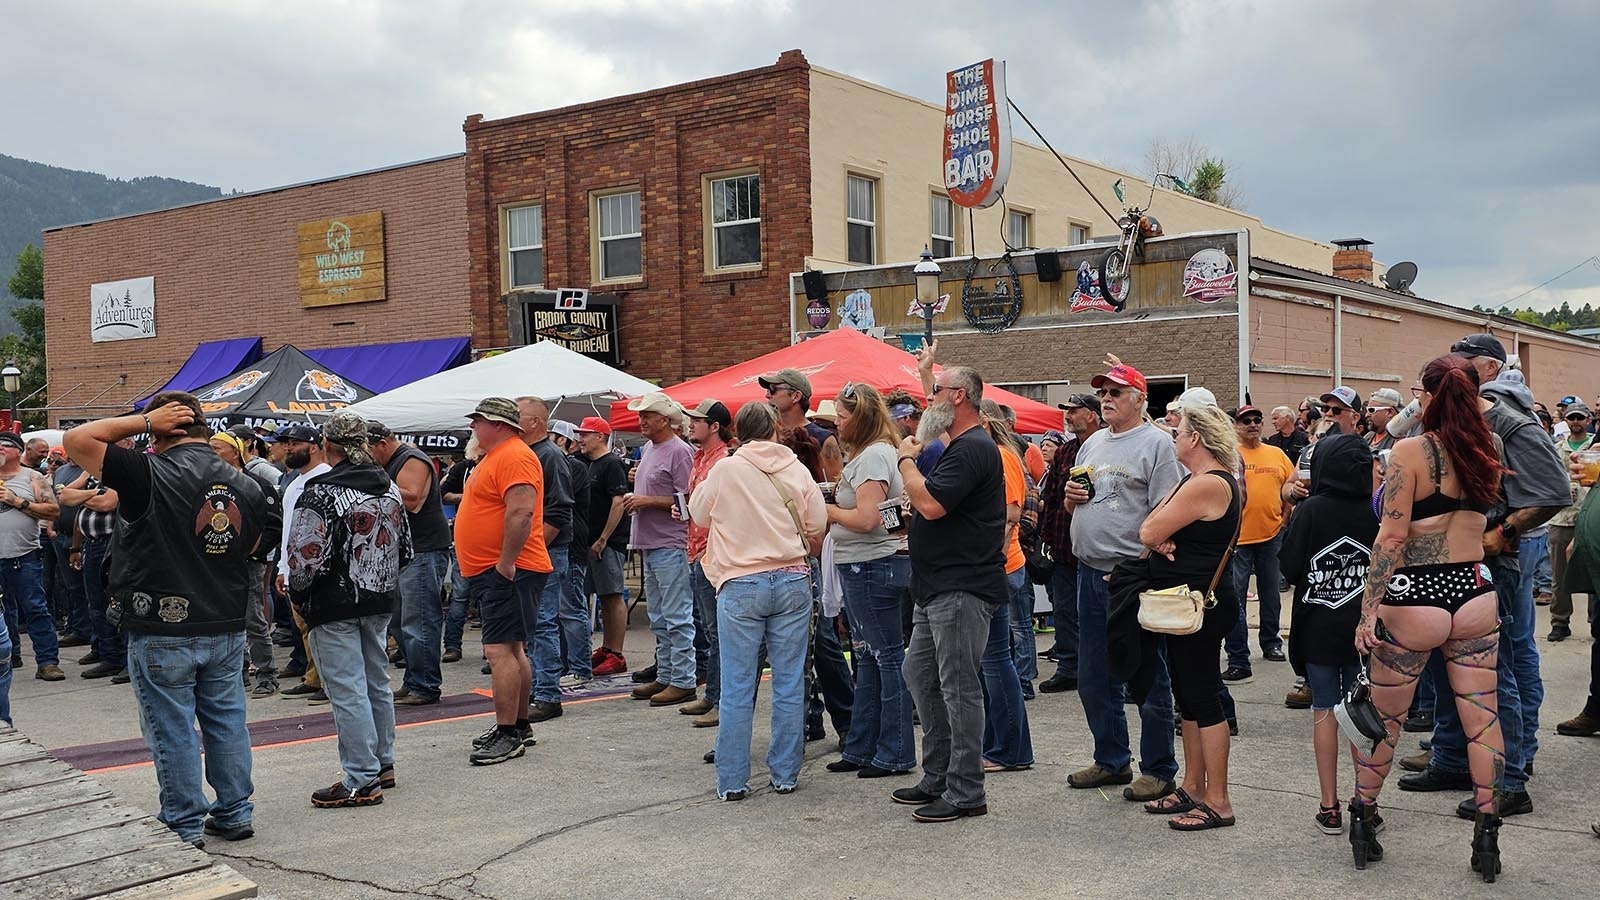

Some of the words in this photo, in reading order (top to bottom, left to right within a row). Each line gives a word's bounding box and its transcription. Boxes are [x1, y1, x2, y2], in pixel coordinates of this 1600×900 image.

[953, 64, 984, 87] THE
[948, 84, 989, 110] DIME
[945, 103, 993, 129] HORSE
[948, 125, 990, 150] SHOE
[945, 149, 994, 189] BAR
[315, 254, 338, 269] WILD
[340, 249, 365, 266] WEST
[318, 266, 362, 283] ESPRESSO
[95, 305, 153, 325] Adventures
[534, 311, 567, 330] CROOK
[570, 311, 607, 330] COUNTY
[807, 307, 831, 315] REDD'S
[141, 318, 154, 334] 301
[570, 334, 609, 352] BUREAU
[204, 489, 236, 501] AMERICAN
[207, 530, 232, 540] LEGION
